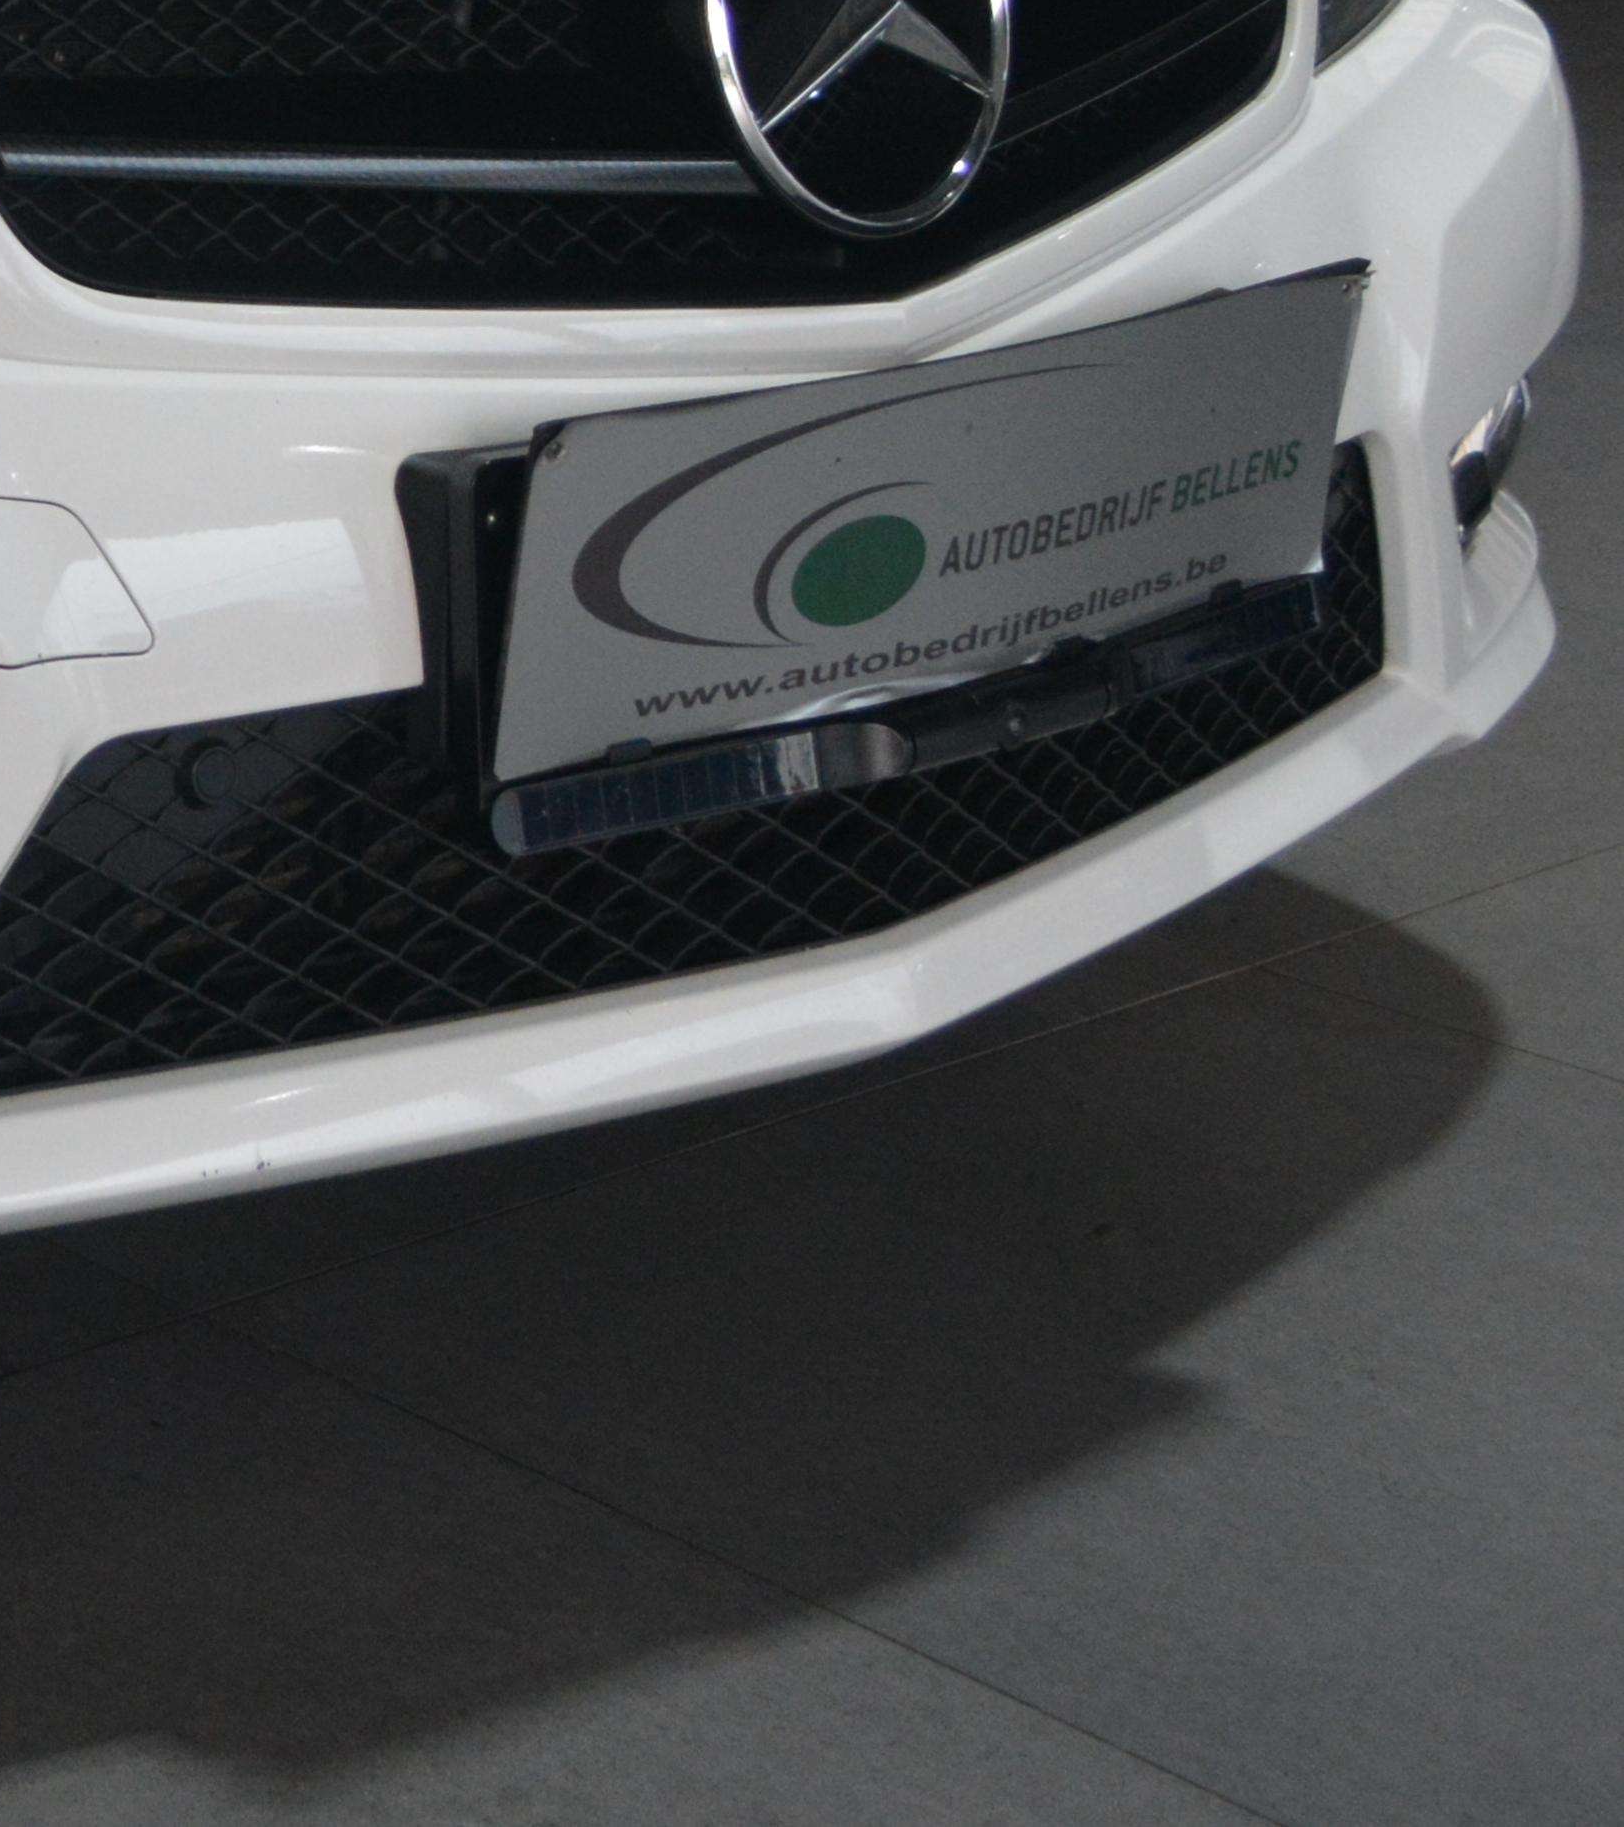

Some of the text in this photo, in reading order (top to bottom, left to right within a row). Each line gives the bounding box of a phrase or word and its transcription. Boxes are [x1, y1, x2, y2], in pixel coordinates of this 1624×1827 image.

[940, 440, 1301, 577] AUTOBEDRIJF BELLENS
[634, 554, 1227, 718] www.autobedrijfbellens.be
